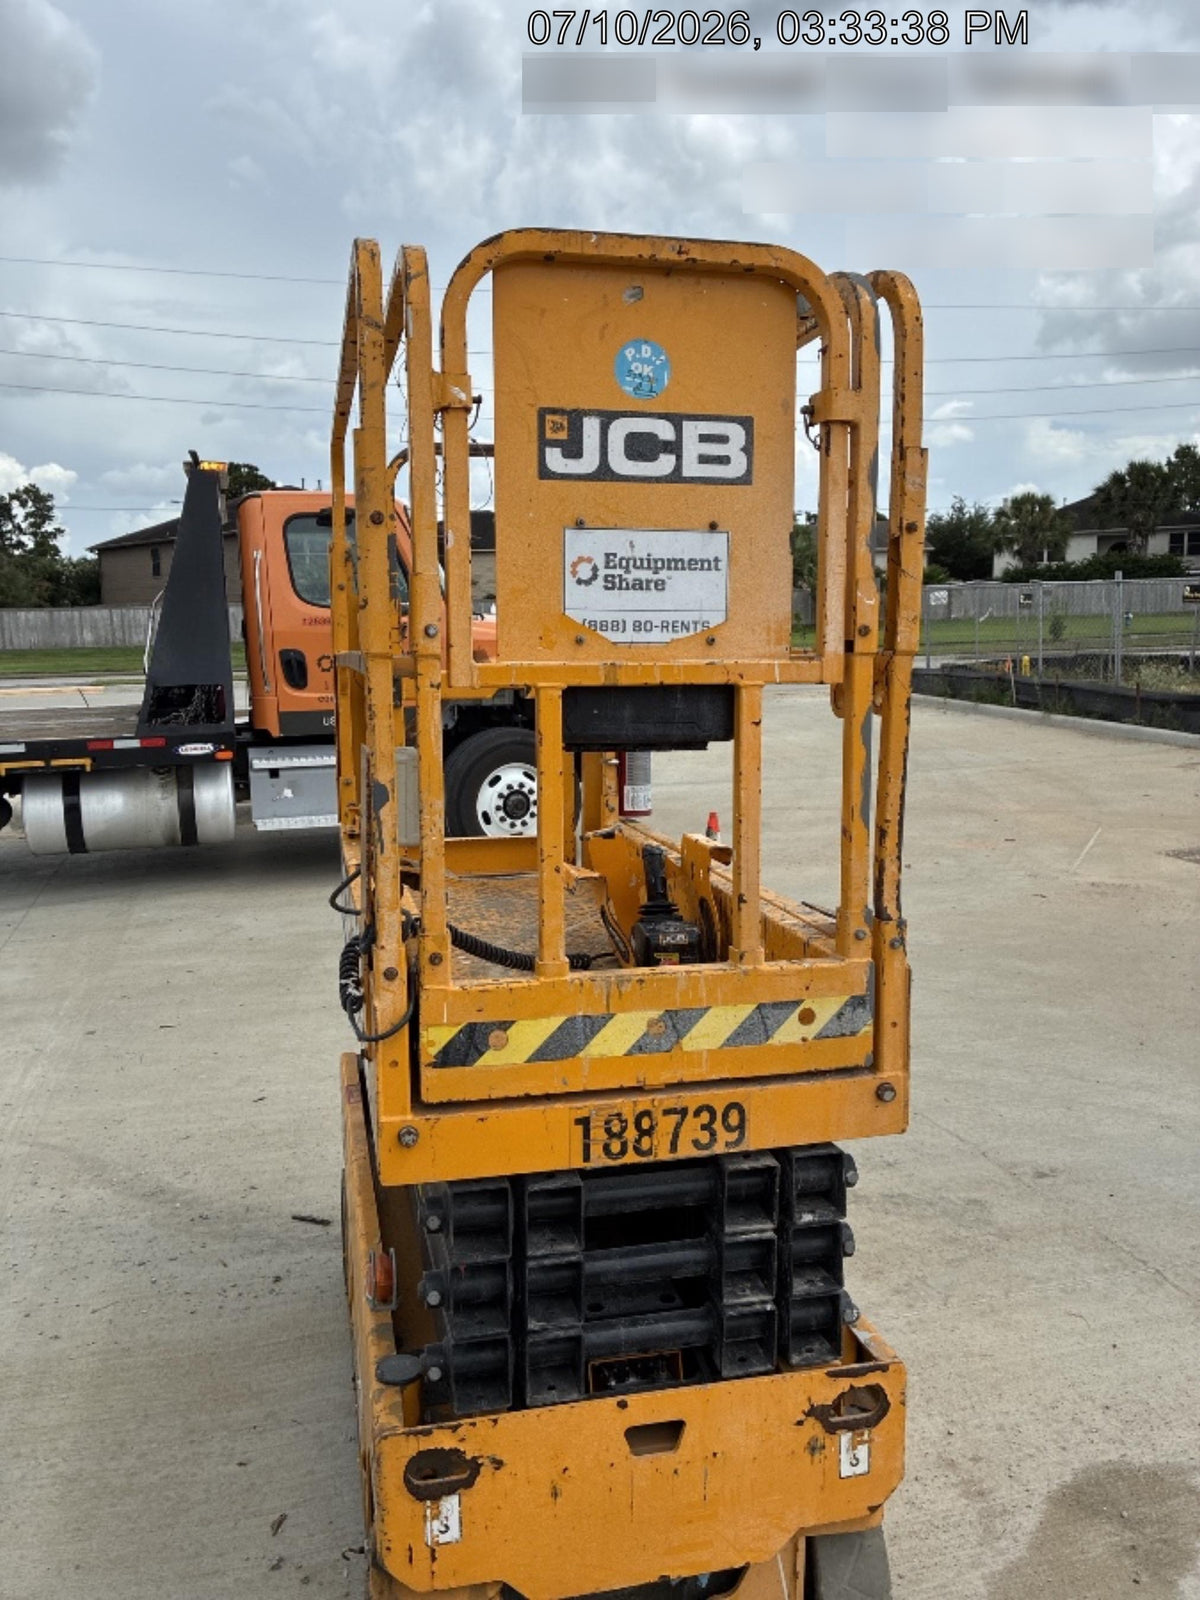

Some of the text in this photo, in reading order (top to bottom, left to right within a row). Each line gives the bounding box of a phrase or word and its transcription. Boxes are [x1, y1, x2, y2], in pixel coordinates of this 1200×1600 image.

[544, 415, 749, 479] JCB
[603, 552, 722, 575] Equipment
[602, 573, 667, 592] Share
[632, 619, 711, 633] 80-RENTS
[573, 1101, 747, 1164] 188739
